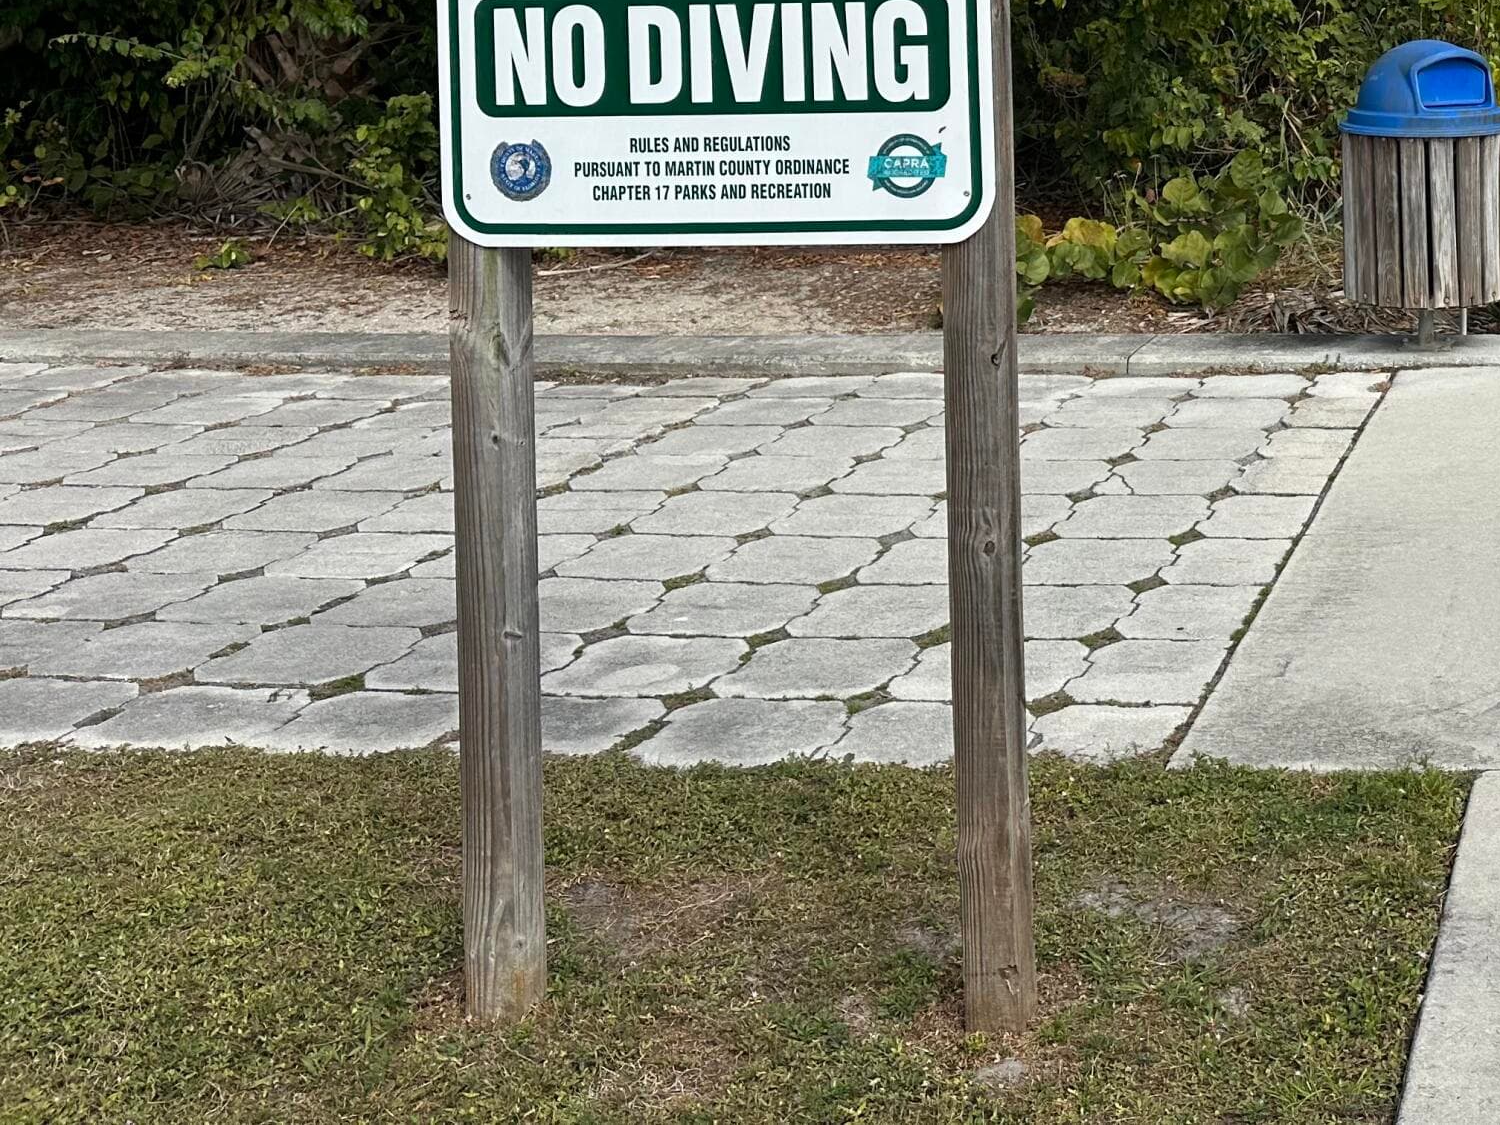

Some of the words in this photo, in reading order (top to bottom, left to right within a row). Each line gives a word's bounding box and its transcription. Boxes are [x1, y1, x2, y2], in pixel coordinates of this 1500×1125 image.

[493, 4, 606, 107] NO
[629, 136, 670, 154] RULES
[673, 135, 700, 152] AND
[703, 134, 791, 153] REGULATIONS
[574, 160, 641, 178] PURSUANT
[644, 160, 661, 177] TO
[664, 159, 716, 176] MARTIN
[719, 158, 772, 177] COUNTY
[775, 157, 851, 176] ORDINANCE
[884, 157, 929, 169] CAPRA
[592, 183, 651, 201] CHAPTER
[654, 184, 670, 200] 17
[673, 182, 716, 201] PARKS
[719, 183, 747, 200] AND
[750, 181, 831, 200] RECREATION
